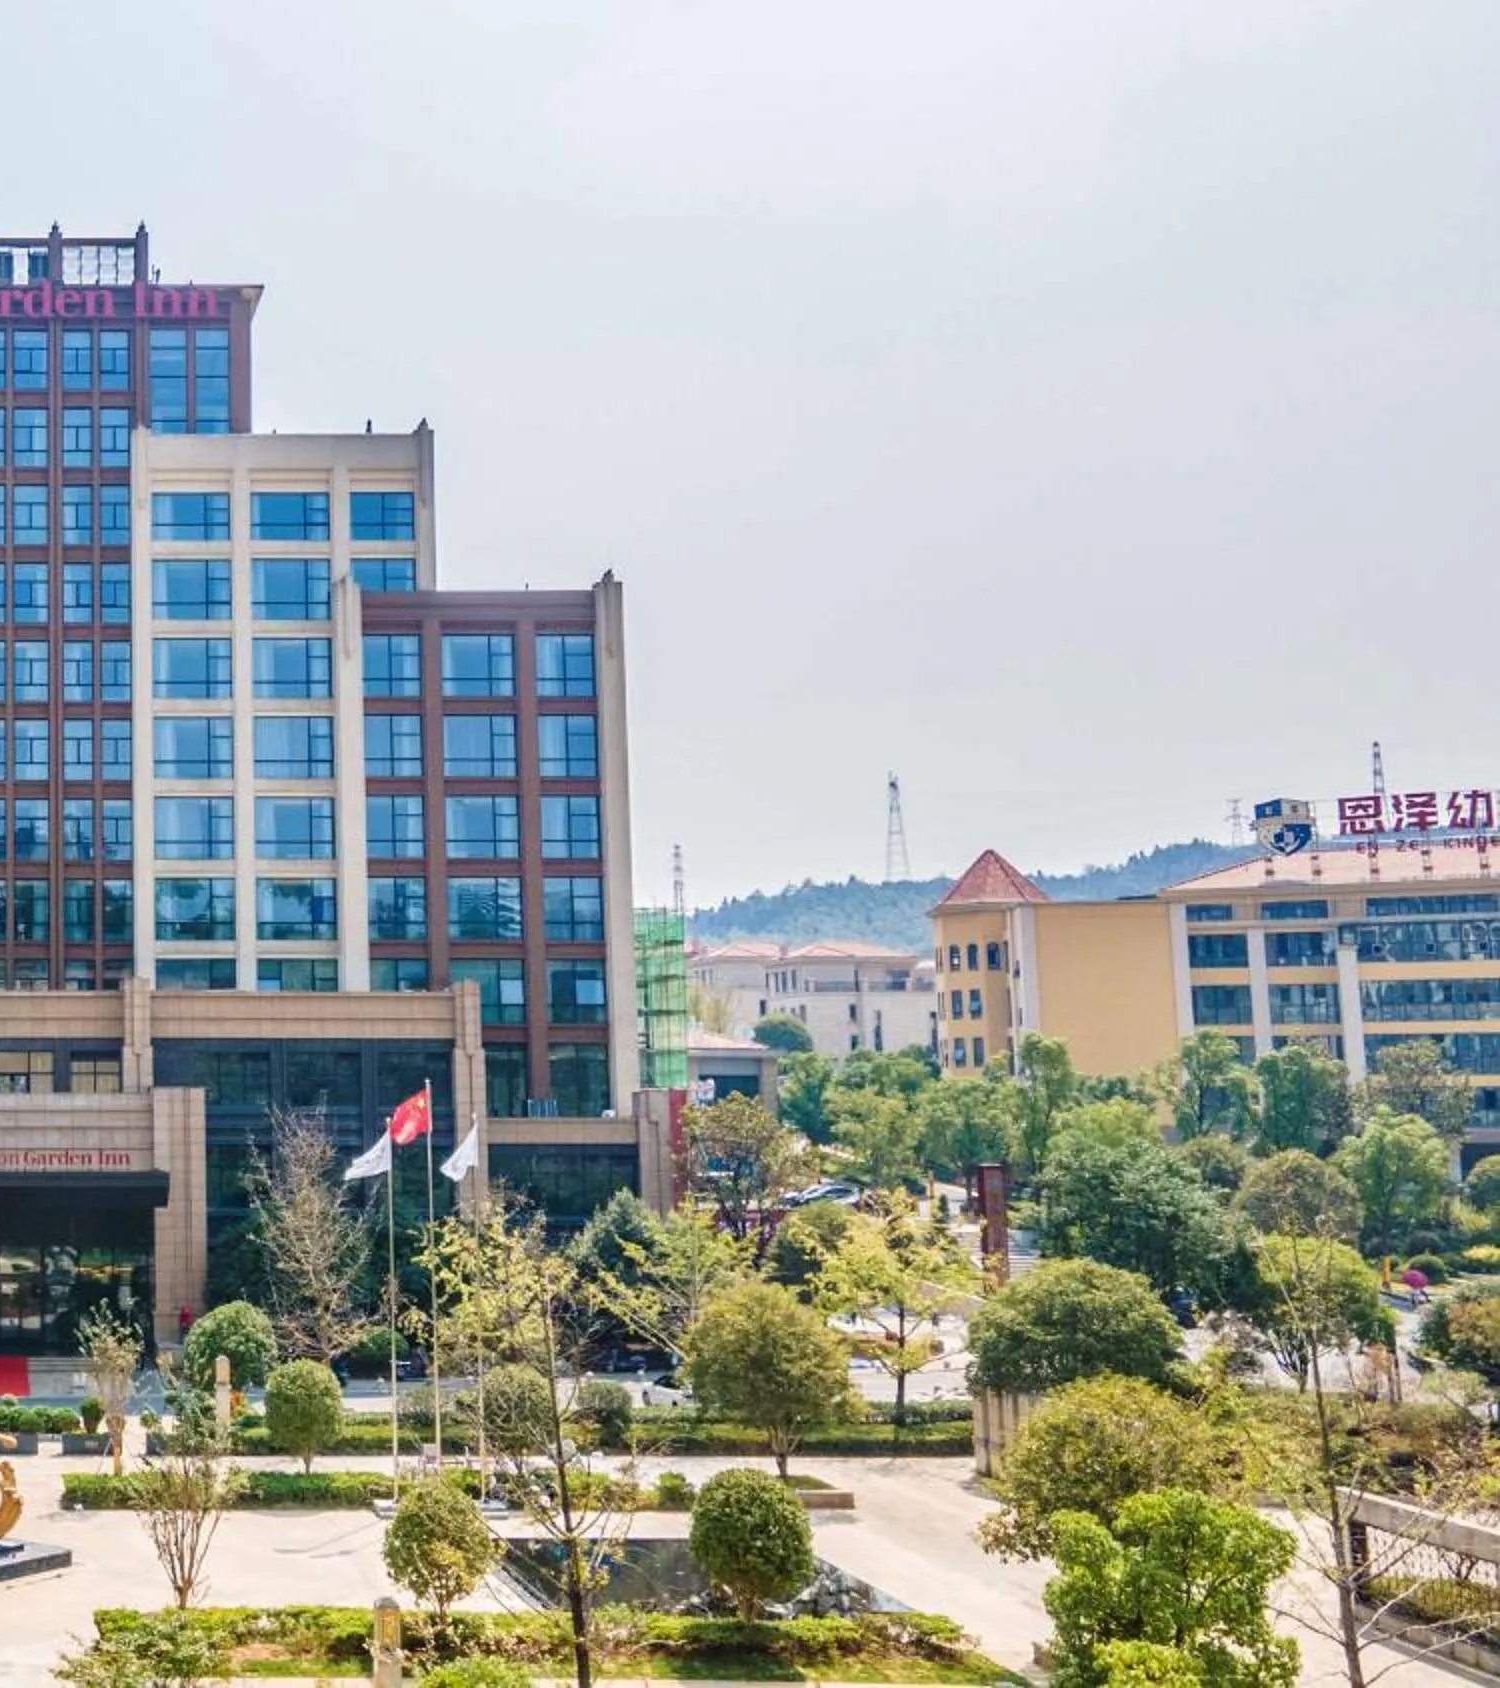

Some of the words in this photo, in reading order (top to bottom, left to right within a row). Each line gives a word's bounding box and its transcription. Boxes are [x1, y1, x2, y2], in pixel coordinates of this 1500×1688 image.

[132, 279, 218, 318] Inn
[1337, 790, 1495, 835] 恩泽幼
[23, 1150, 93, 1166] Garden
[98, 1150, 131, 1166] Inn
